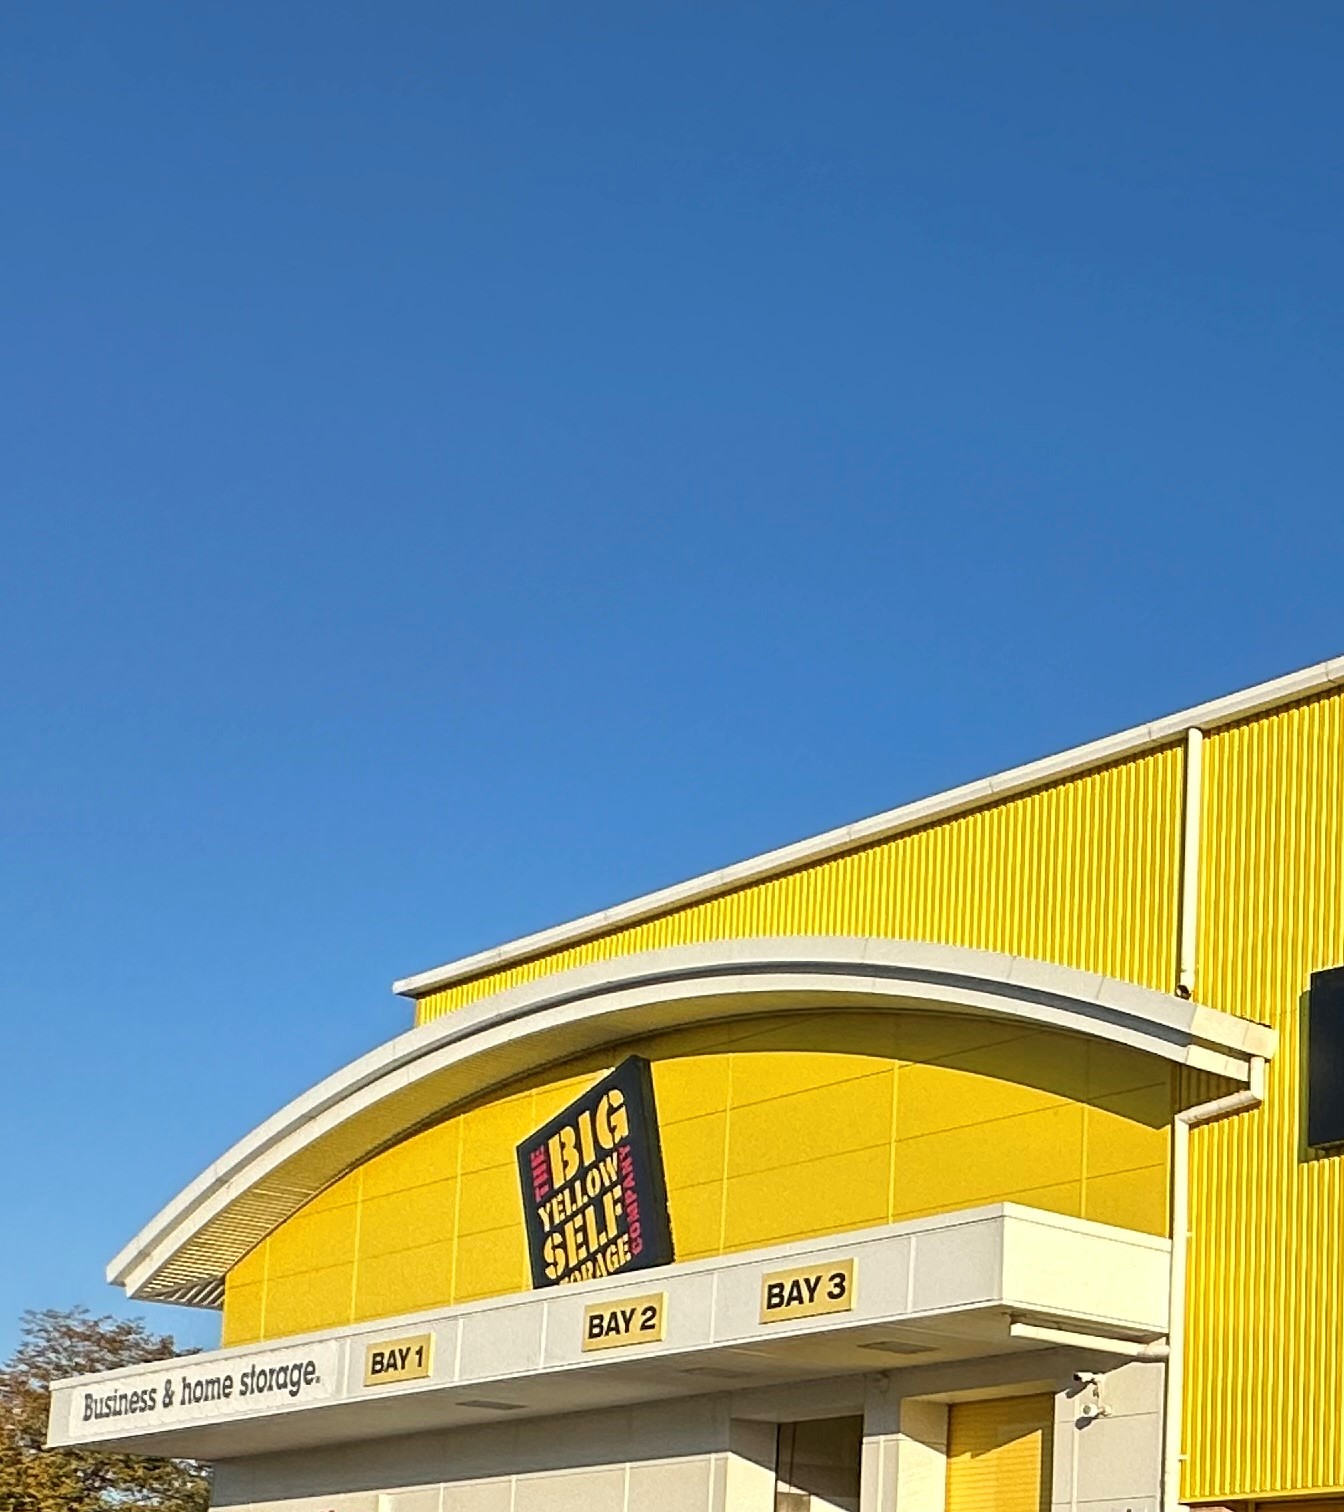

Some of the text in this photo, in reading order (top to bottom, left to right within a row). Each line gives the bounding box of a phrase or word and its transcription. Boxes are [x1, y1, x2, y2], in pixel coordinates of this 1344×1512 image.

[548, 1089, 629, 1189] BIG
[530, 1145, 550, 1203] THE
[538, 1152, 618, 1232] YELLOW
[618, 1144, 644, 1256] COMPANY
[543, 1184, 624, 1280] SELF
[588, 1305, 657, 1339] BAY 2
[766, 1272, 846, 1310] BAY 3
[83, 1359, 321, 1422] Business & home storage.
[371, 1345, 424, 1375] BAY 1
